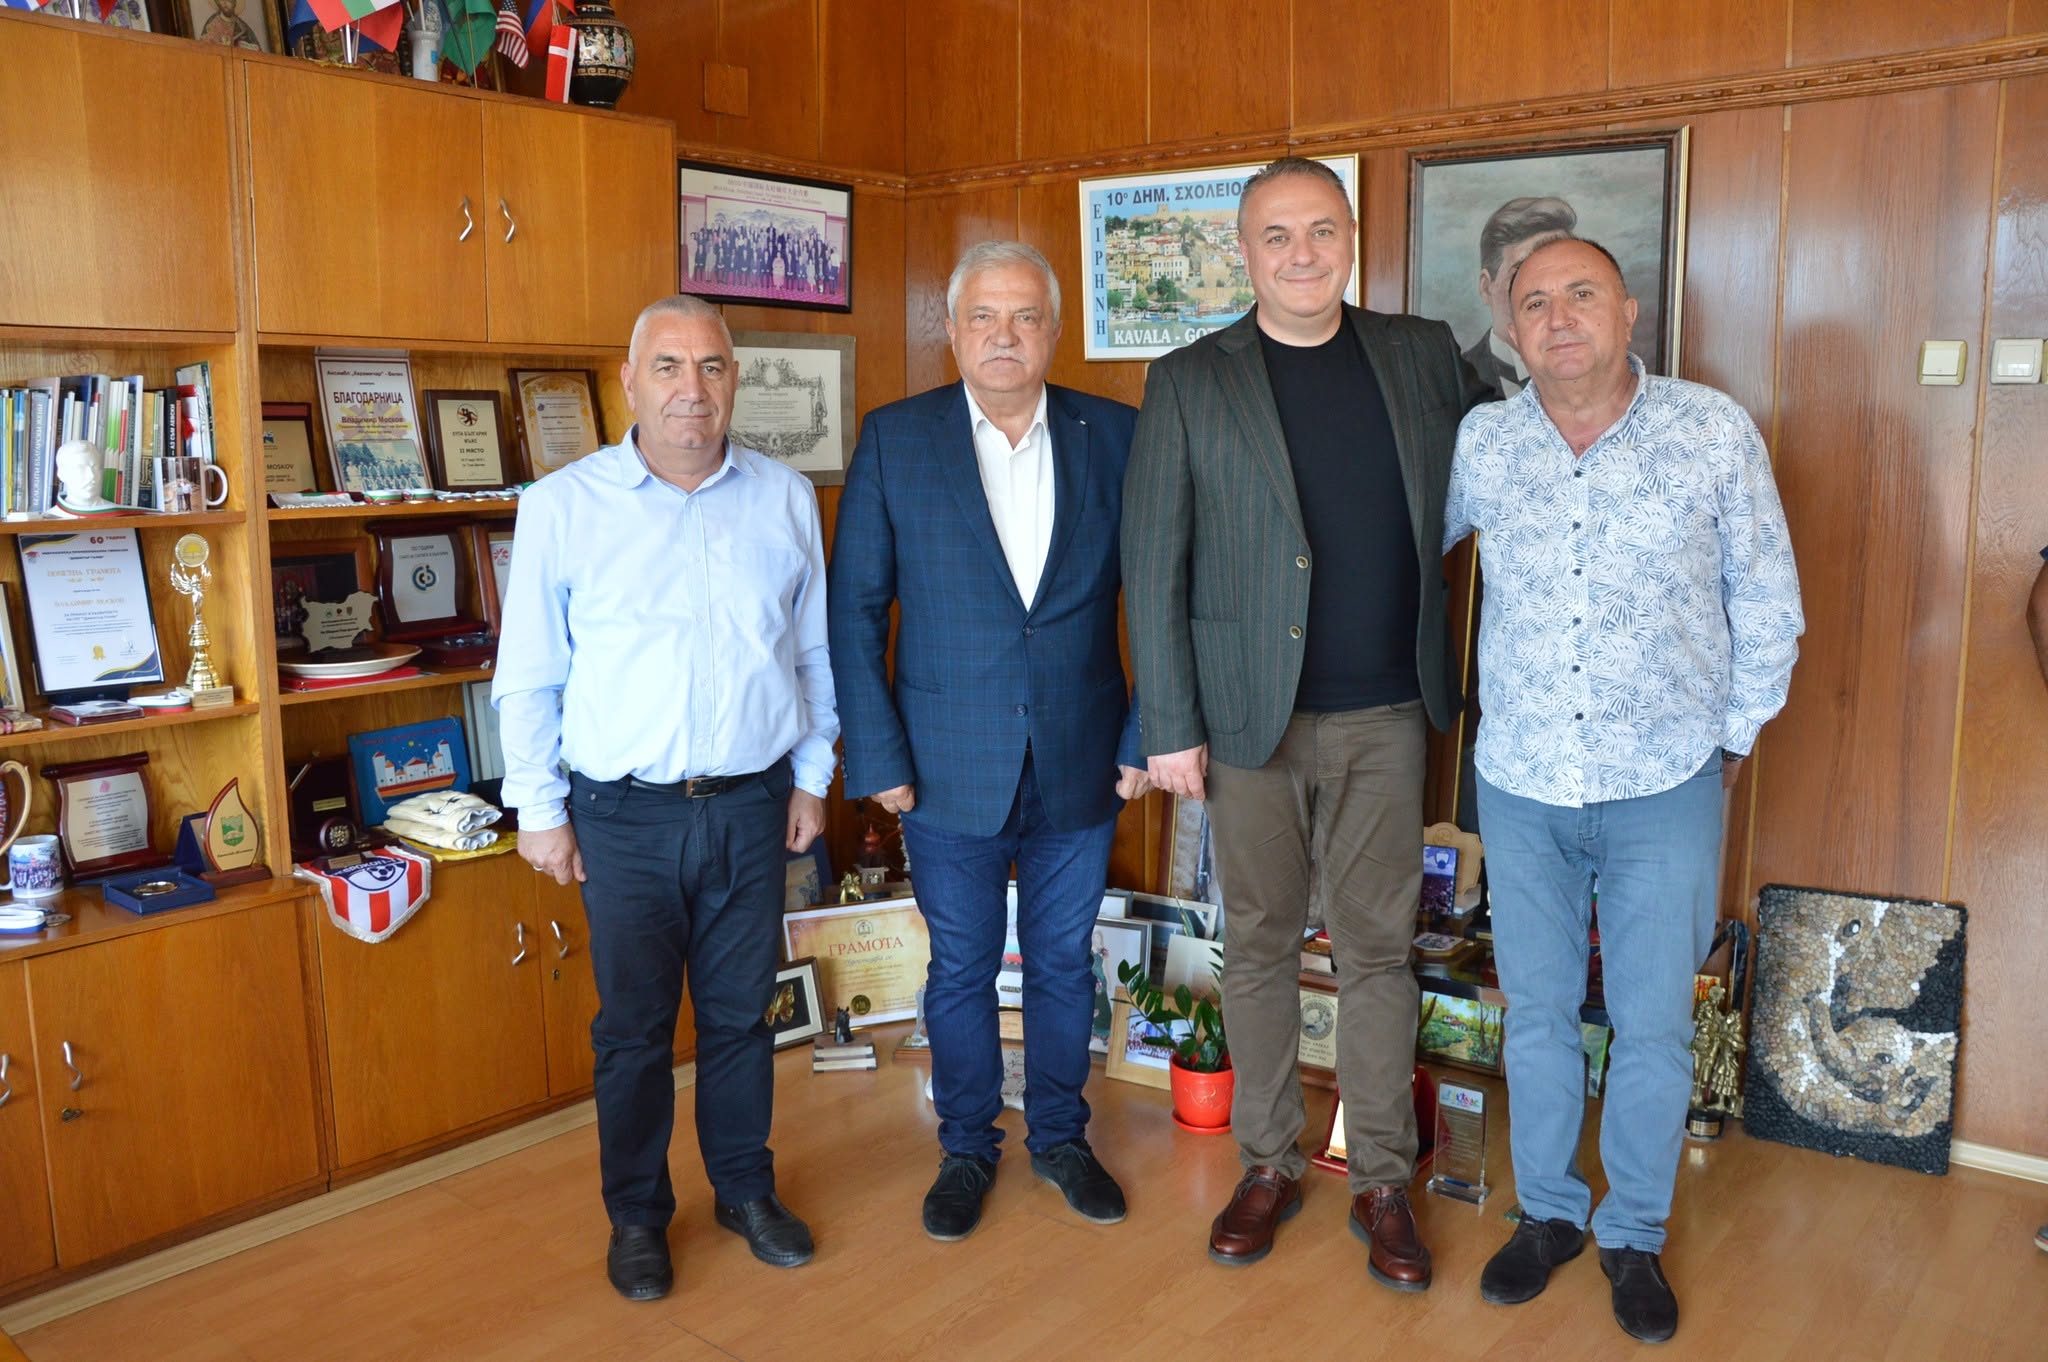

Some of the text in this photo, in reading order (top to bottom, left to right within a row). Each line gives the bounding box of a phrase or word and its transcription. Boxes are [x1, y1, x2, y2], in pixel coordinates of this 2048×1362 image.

[1132, 186, 1170, 203] ΔΗΜ.
[1114, 329, 1171, 345] KAVALA
[333, 391, 404, 406] БЛАГОДАРНИЦА
[89, 536, 104, 544] 60
[828, 936, 904, 957] ГРАМОТА
